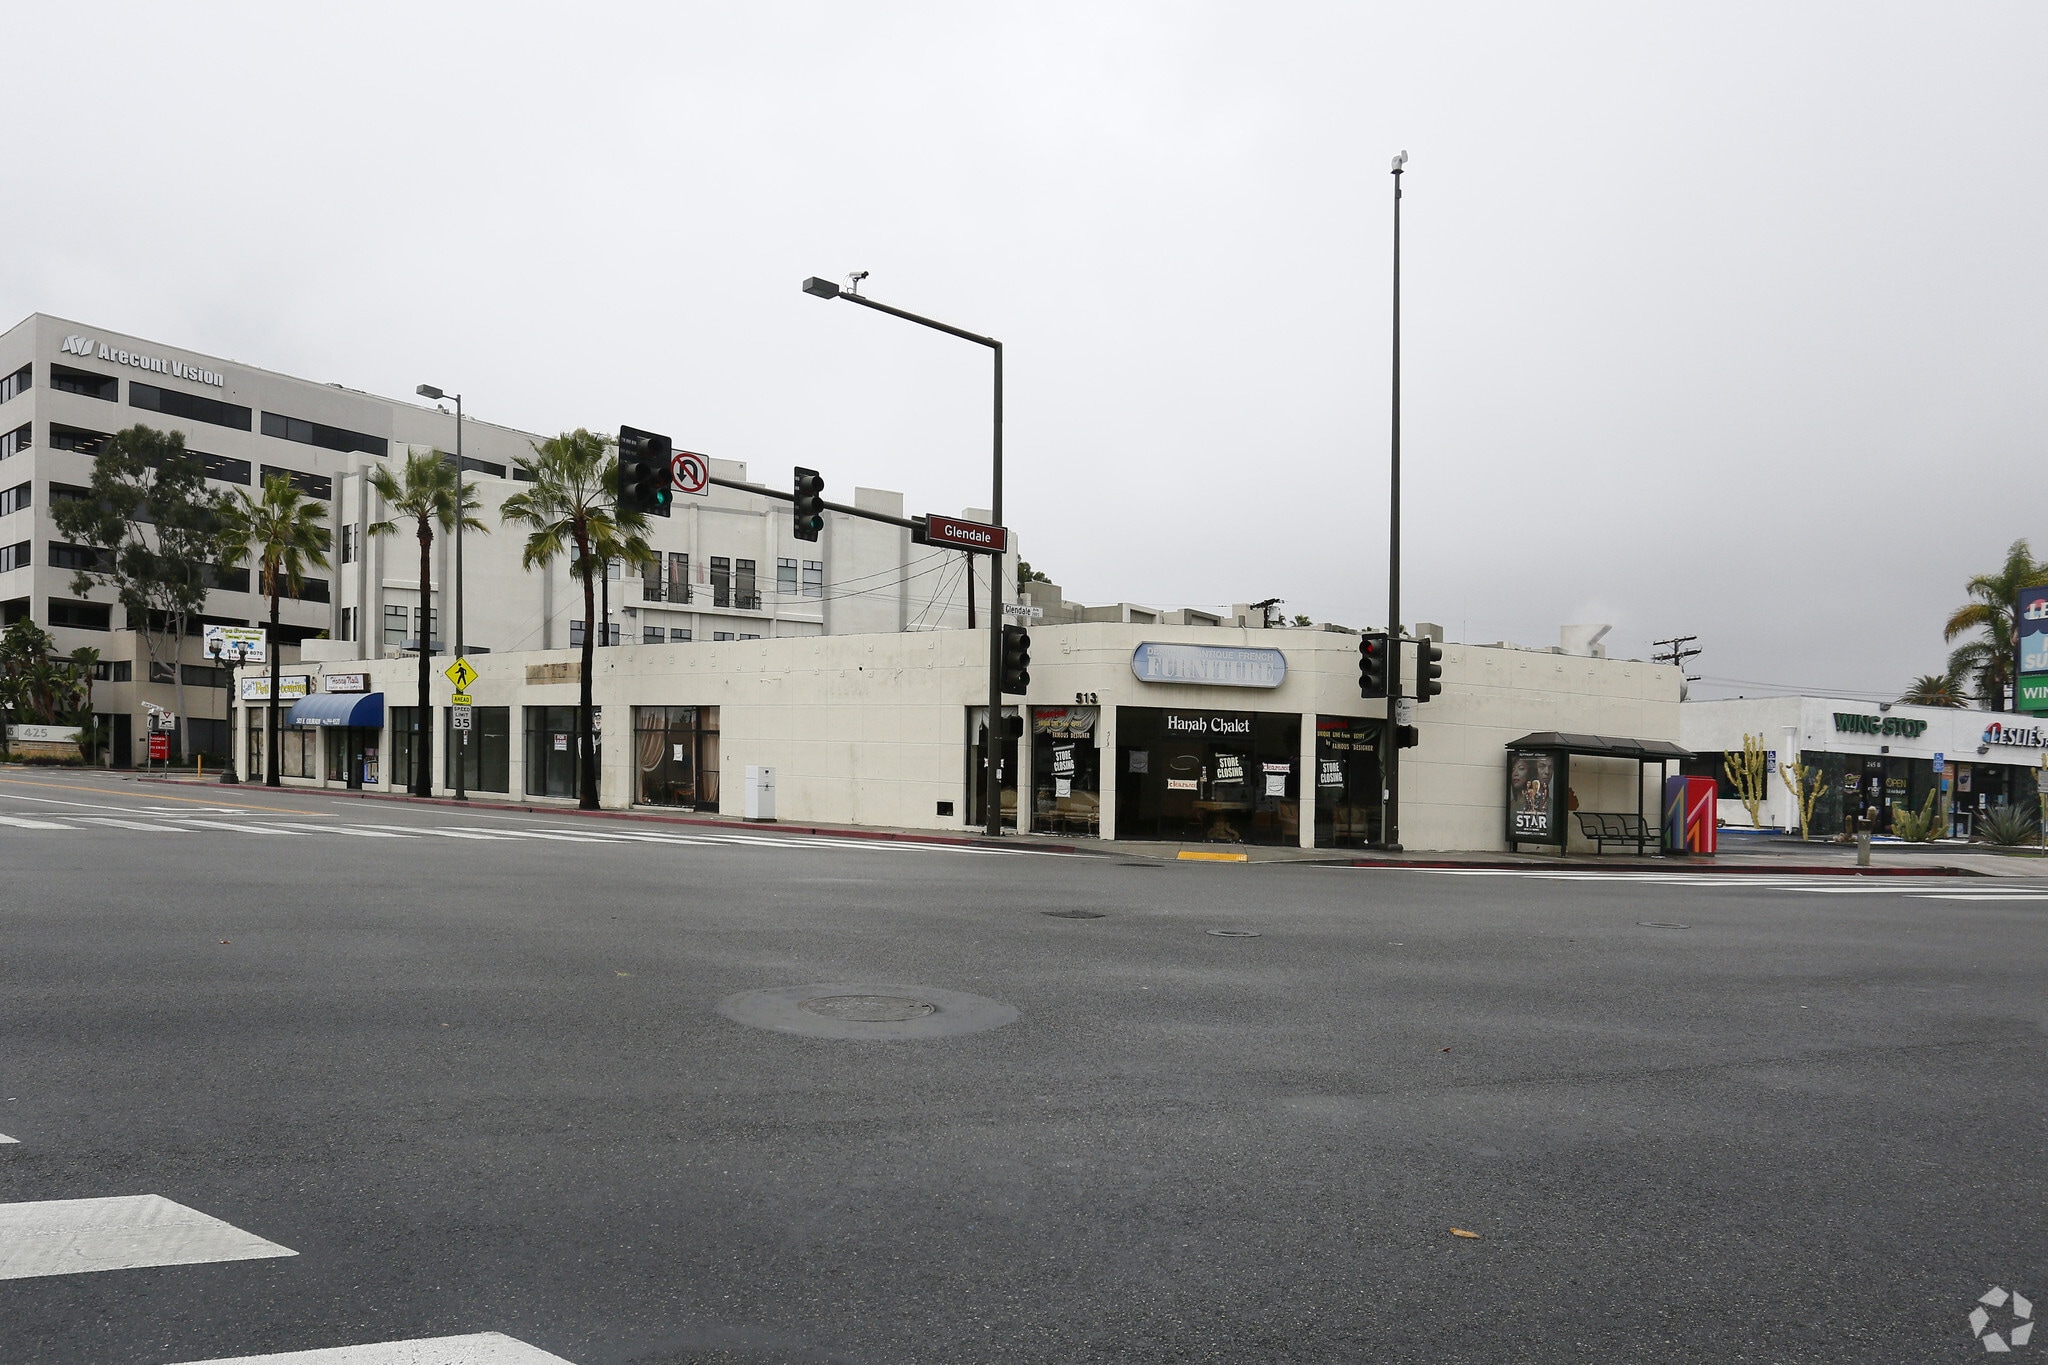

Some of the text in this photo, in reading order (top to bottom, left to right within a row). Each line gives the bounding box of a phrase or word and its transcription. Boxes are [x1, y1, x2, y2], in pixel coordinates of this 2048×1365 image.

[98, 342, 224, 387] Arecont Vision
[944, 524, 991, 543] Glendale
[1005, 604, 1031, 616] Glendale
[1238, 652, 1274, 662] FRENCH
[1146, 656, 1274, 682] FURNITURE
[278, 684, 306, 696] ooming
[1075, 692, 1099, 705] 513
[454, 718, 470, 728] 35
[1167, 715, 1250, 735] Hanah Chalet
[24, 728, 48, 738] 425
[1352, 744, 1374, 752] DESIGNER
[1055, 750, 1072, 762] STORE
[1219, 756, 1240, 768] STORE
[1053, 759, 1075, 772] CLOSING
[1322, 762, 1340, 773] STORE
[1216, 766, 1244, 779] CLOSING
[1320, 772, 1343, 784] CLOSING
[1885, 778, 1907, 788] OPEN
[1516, 814, 1547, 829] STAR
